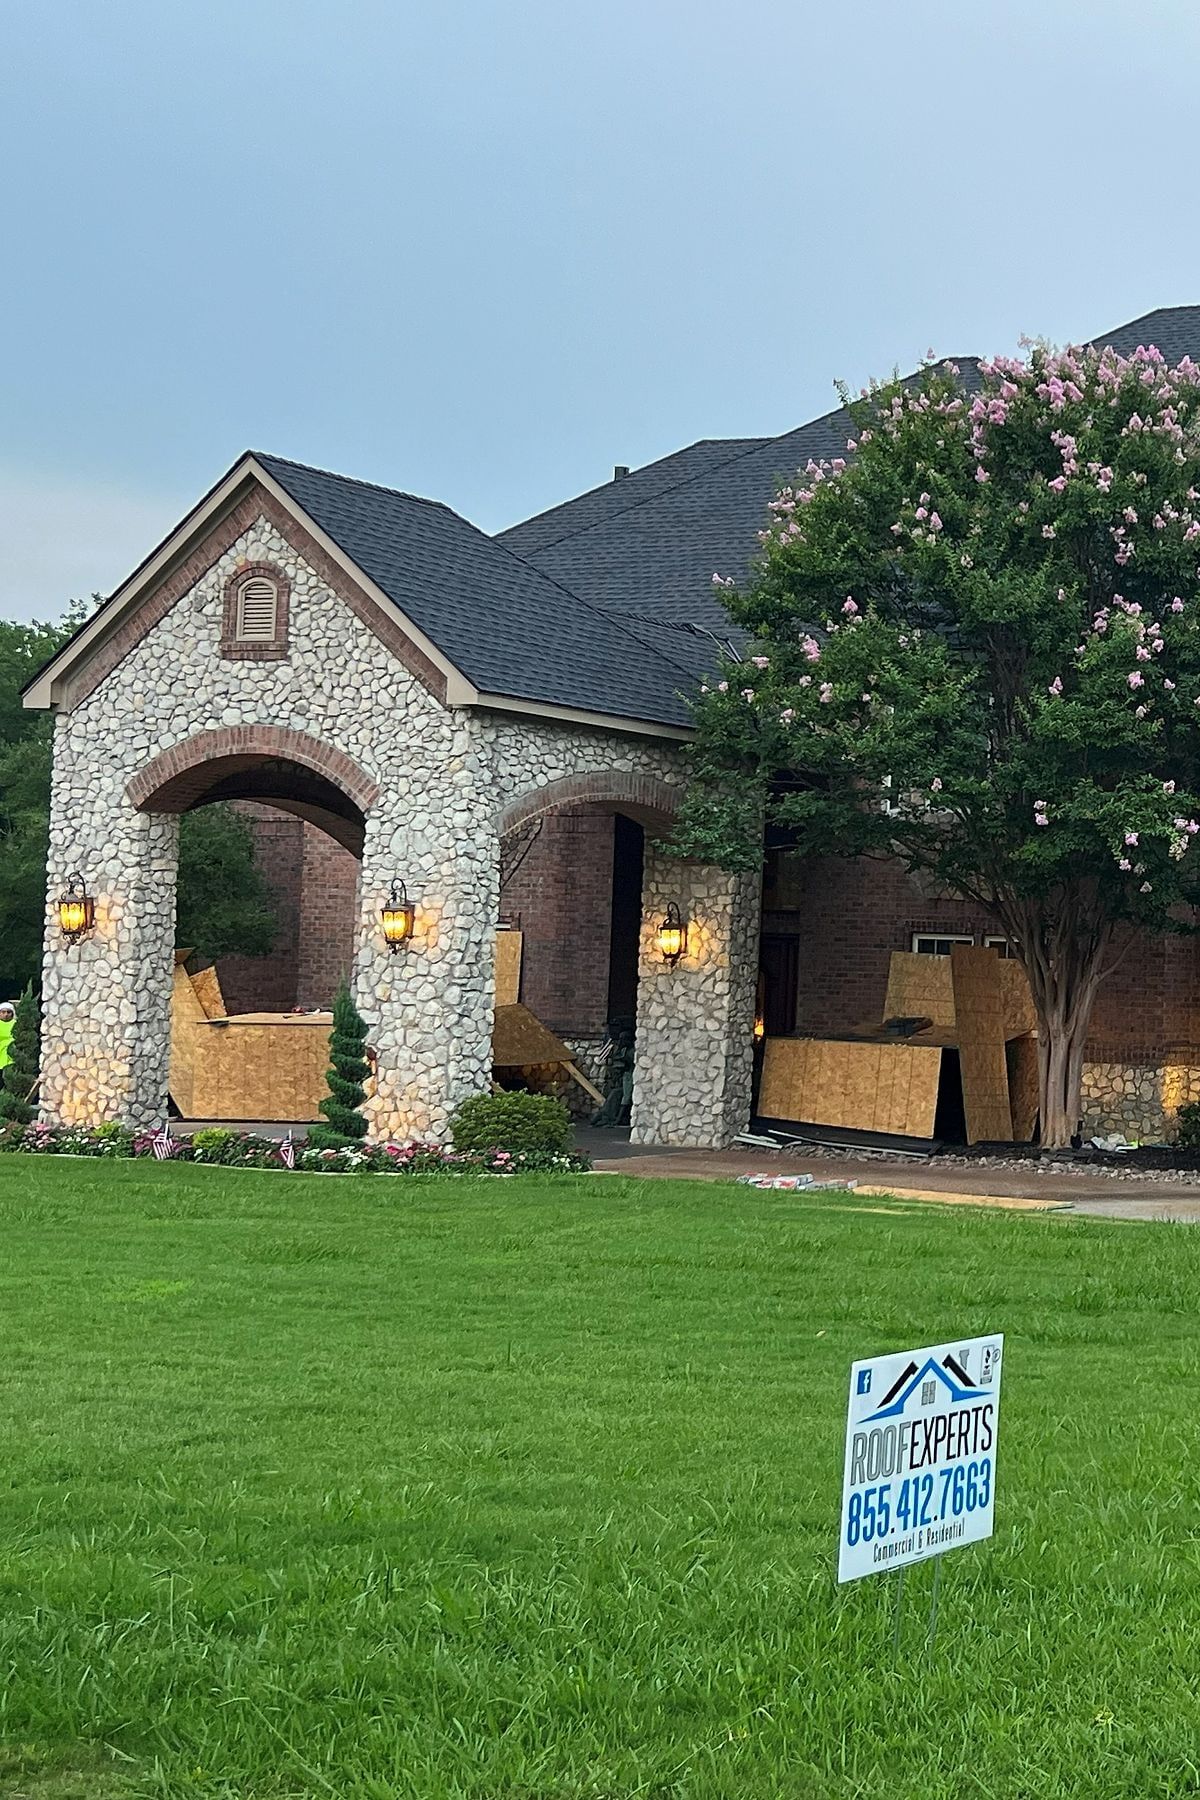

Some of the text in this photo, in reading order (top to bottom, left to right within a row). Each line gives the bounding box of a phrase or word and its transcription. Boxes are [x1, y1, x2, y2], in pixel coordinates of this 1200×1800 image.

[847, 1457, 991, 1547] 855.412.7663
[873, 1517, 965, 1563] Commercial & Residential
